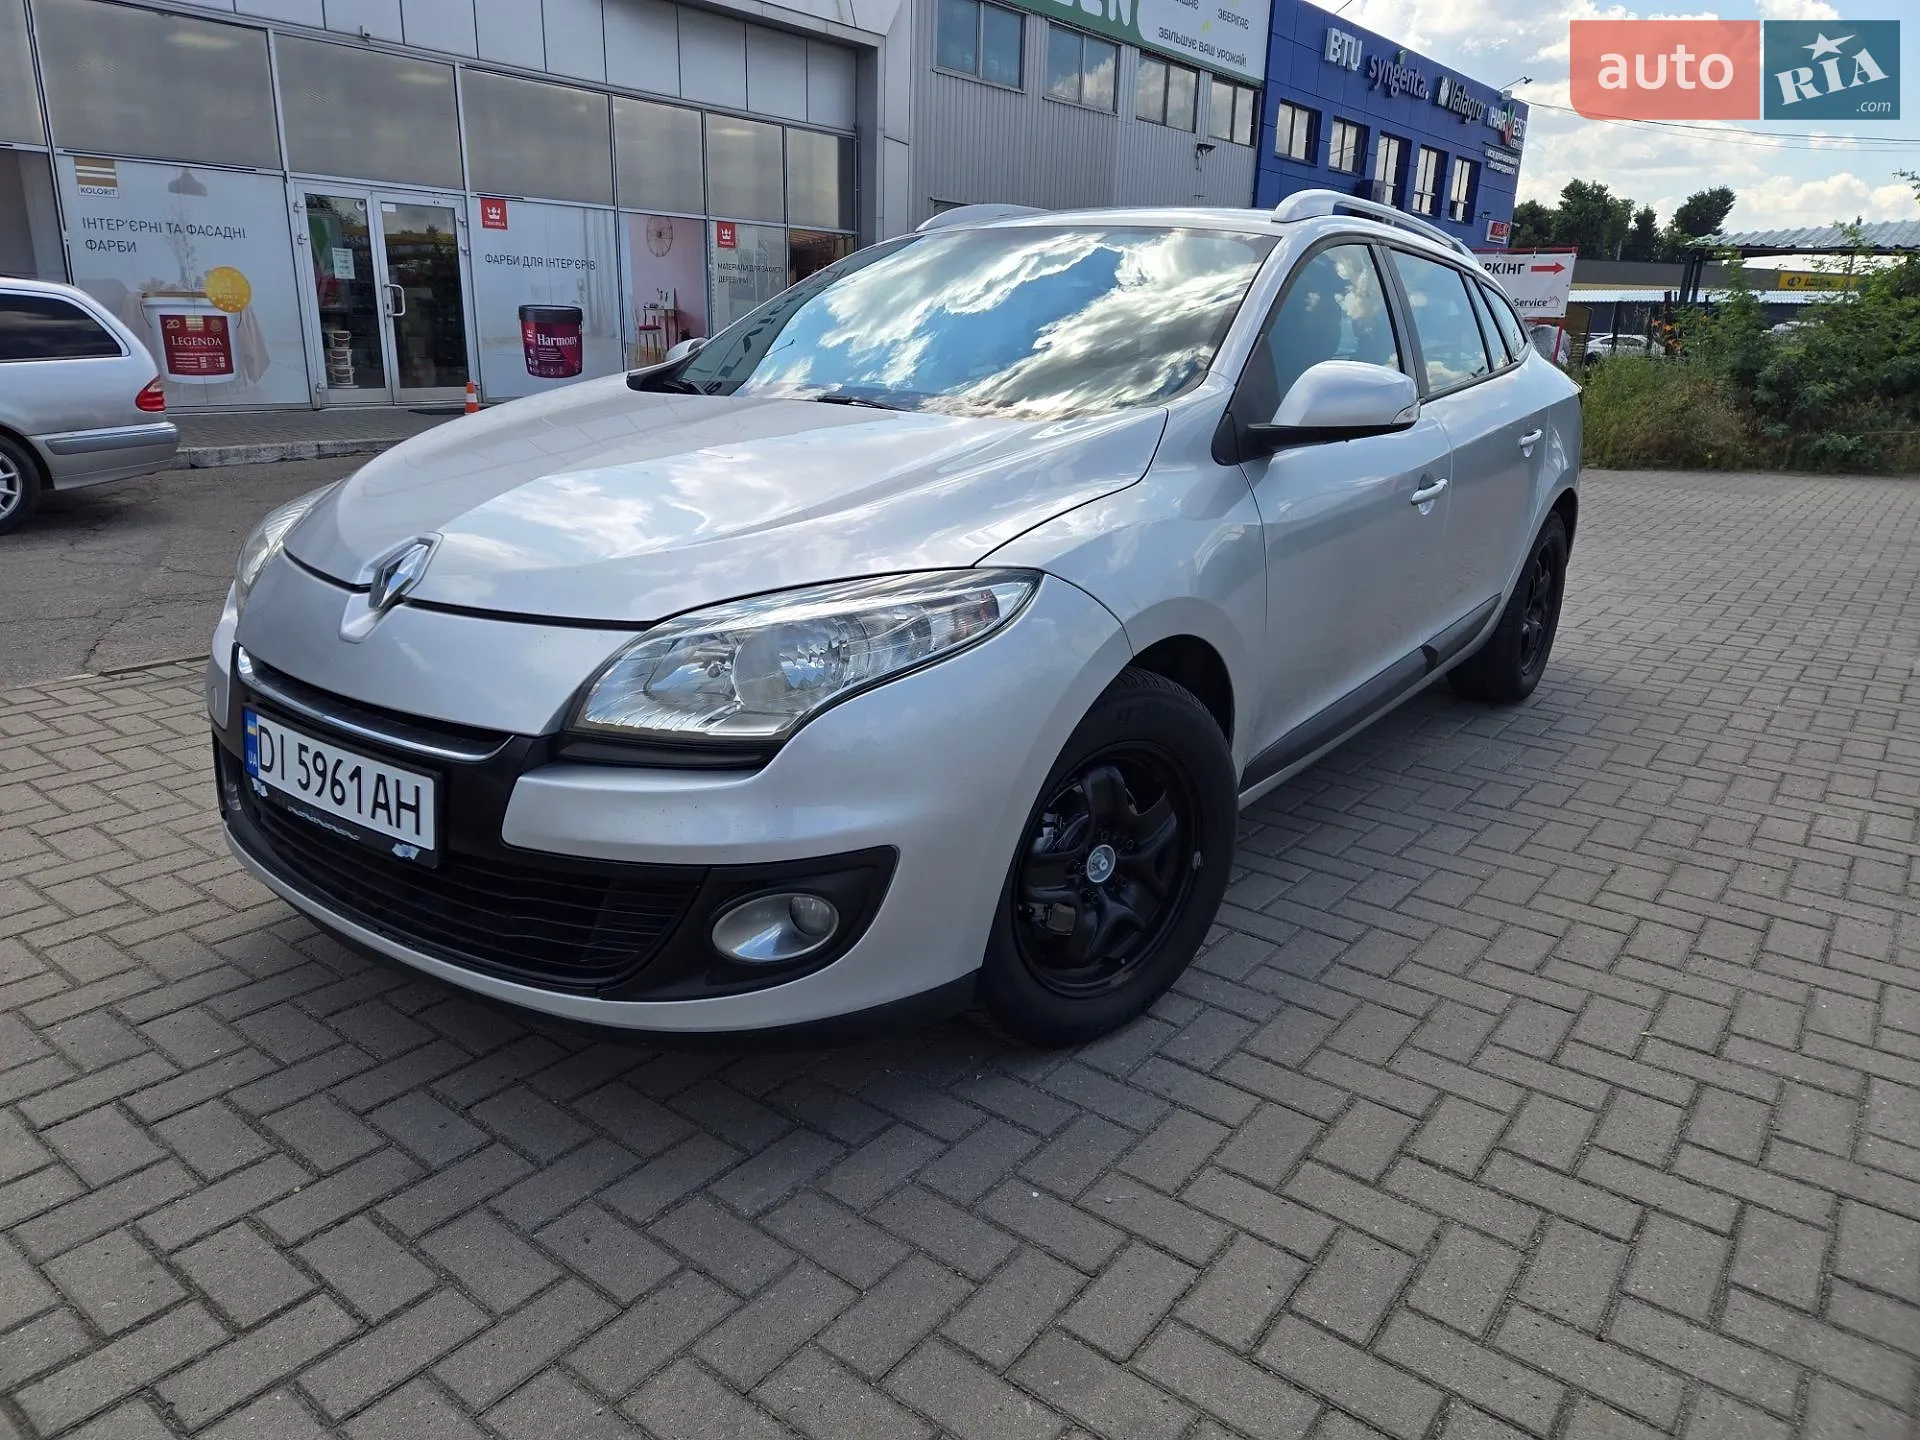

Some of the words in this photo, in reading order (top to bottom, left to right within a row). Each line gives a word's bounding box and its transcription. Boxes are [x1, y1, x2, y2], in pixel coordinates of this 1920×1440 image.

[1158, 26, 1197, 50] ЗБІЛЬШУЄ
[1198, 41, 1216, 56] ВАШ
[1326, 27, 1363, 71] BTU
[80, 186, 117, 196] KOLORIT
[82, 216, 162, 233] ІНТЕР'ЄРНІ
[166, 222, 183, 234] ТА
[186, 223, 246, 240] ФАСАДНІ
[85, 238, 137, 253] ФАРБИ
[484, 253, 520, 266] ФАРБИ
[522, 256, 543, 269] ДЛЯ
[1483, 262, 1525, 275] РКІНГ
[1514, 297, 1548, 307] Service
[171, 335, 223, 346] LEGENDA
[537, 333, 577, 348] Harmony
[248, 750, 258, 768] UA
[258, 724, 285, 781] DI
